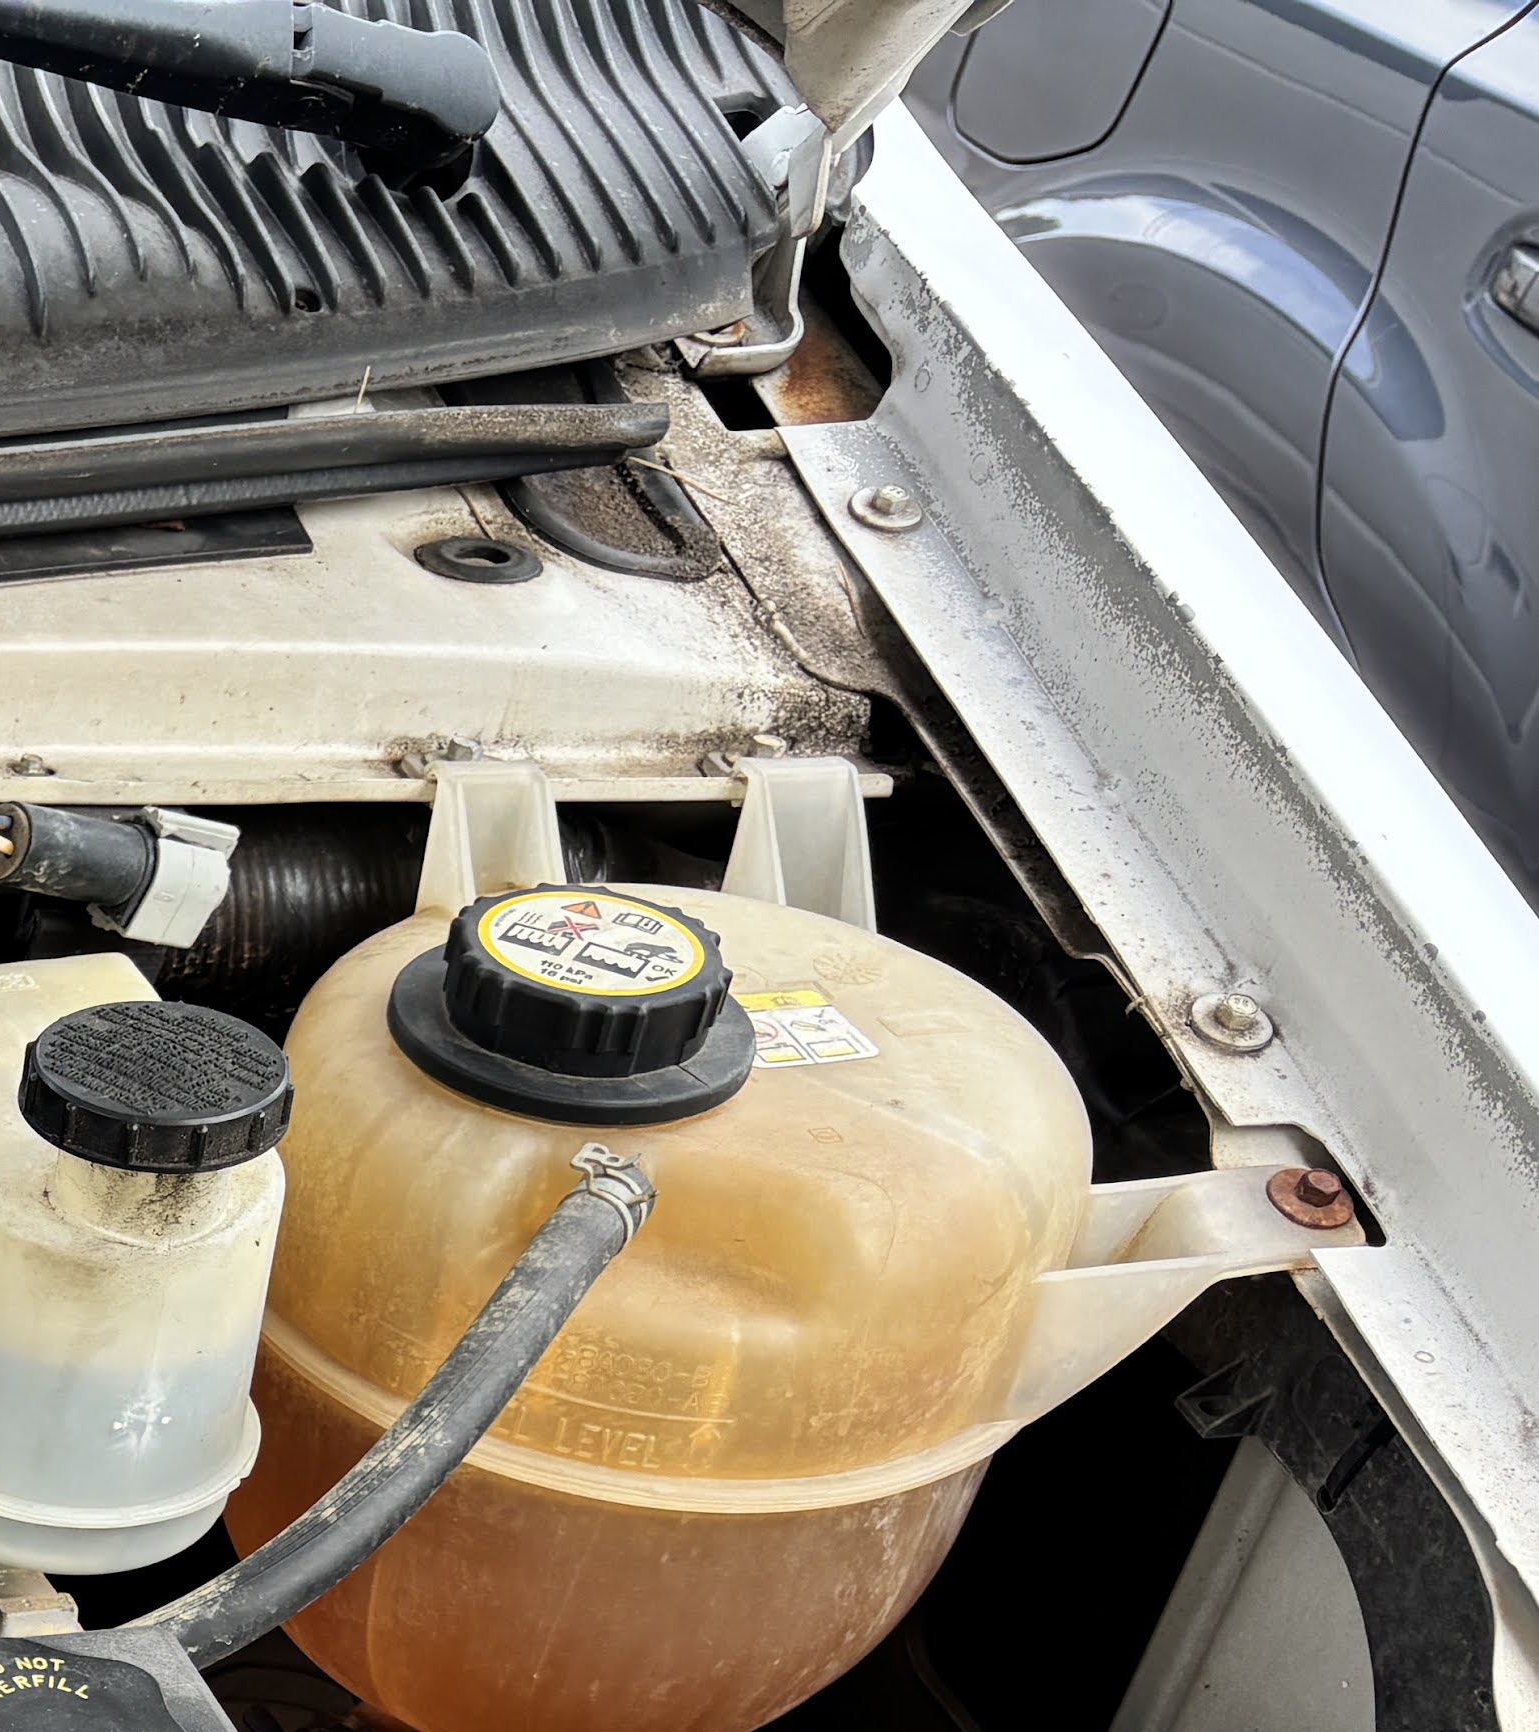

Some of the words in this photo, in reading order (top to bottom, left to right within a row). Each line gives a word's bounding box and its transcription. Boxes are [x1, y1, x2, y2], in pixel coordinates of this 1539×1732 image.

[652, 963, 677, 977] OK
[553, 1416, 661, 1469] LEVEL
[14, 1656, 66, 1673] NOT
